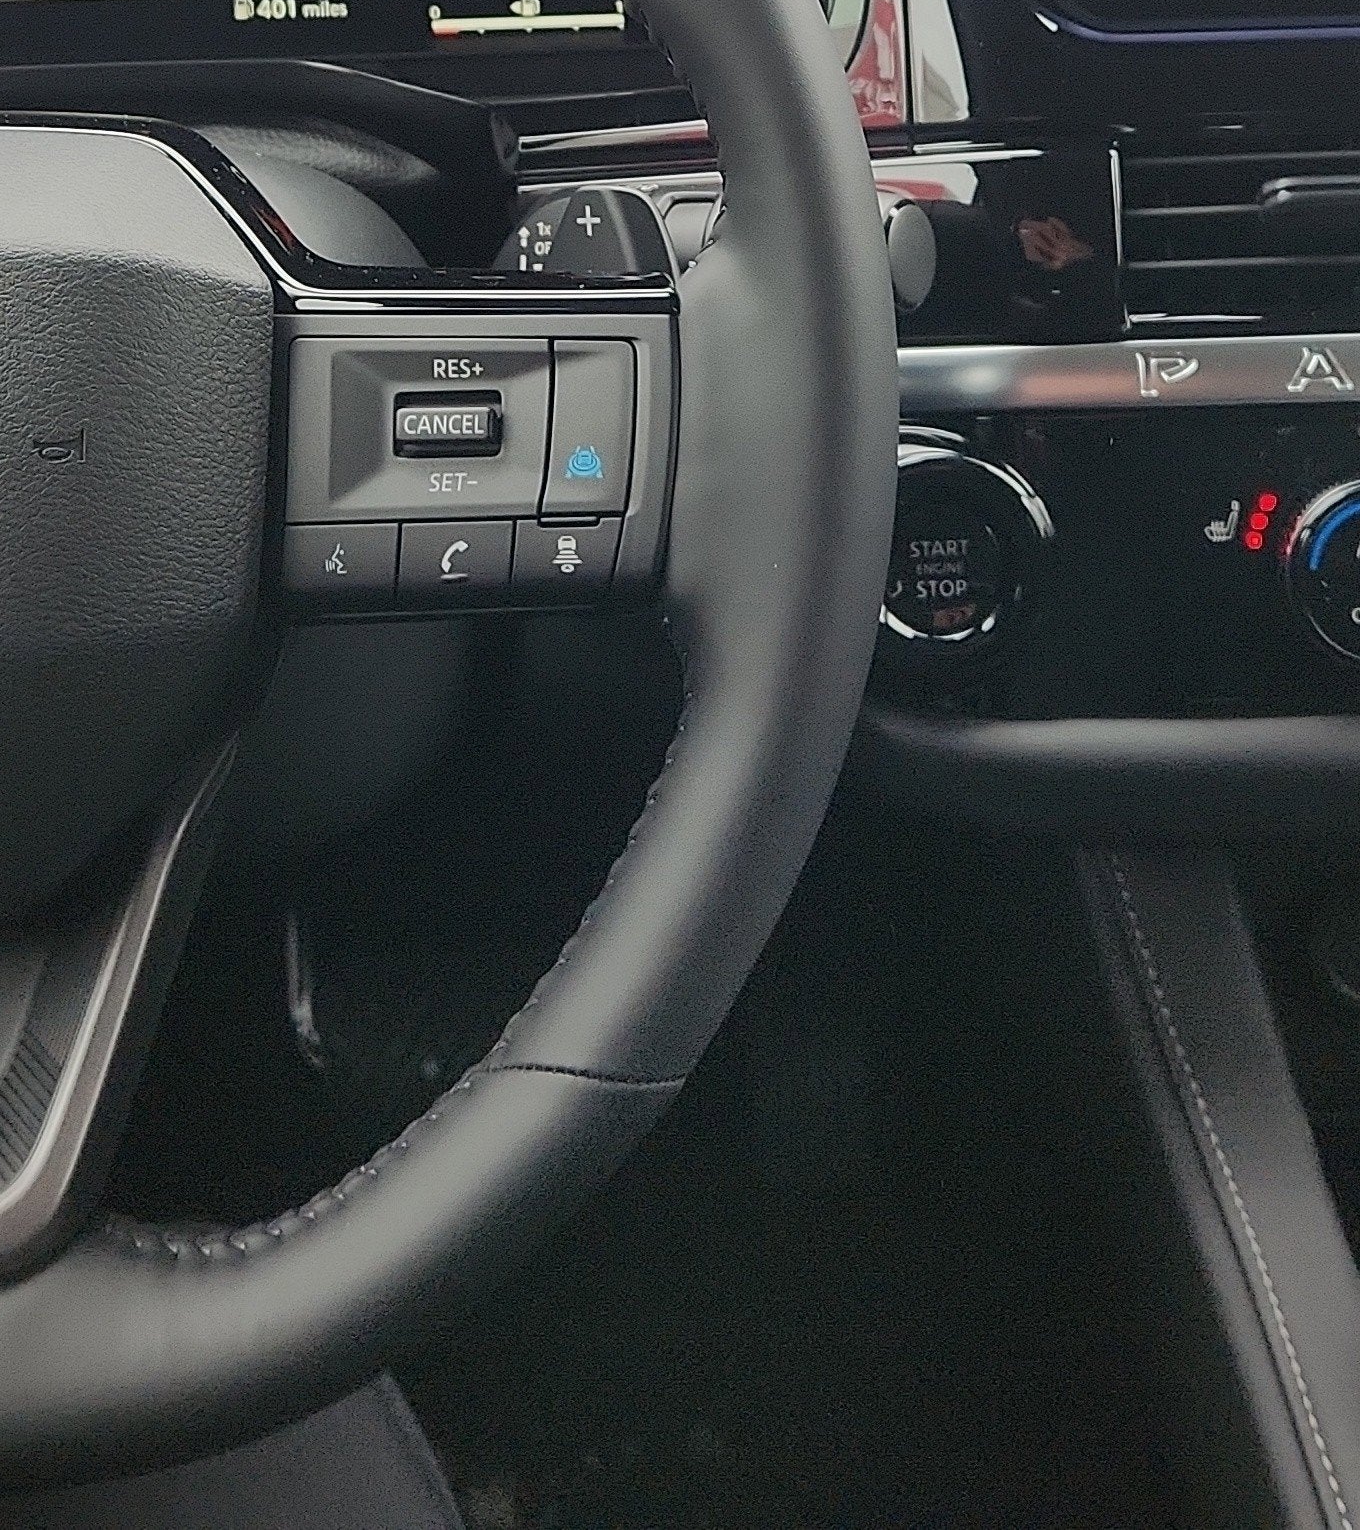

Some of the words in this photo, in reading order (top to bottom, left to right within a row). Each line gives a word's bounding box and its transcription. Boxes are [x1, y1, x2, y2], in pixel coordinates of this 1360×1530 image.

[433, 359, 484, 379] RES+
[404, 415, 485, 436] CANCEL
[909, 539, 968, 558] START
[916, 579, 967, 598] STOP
